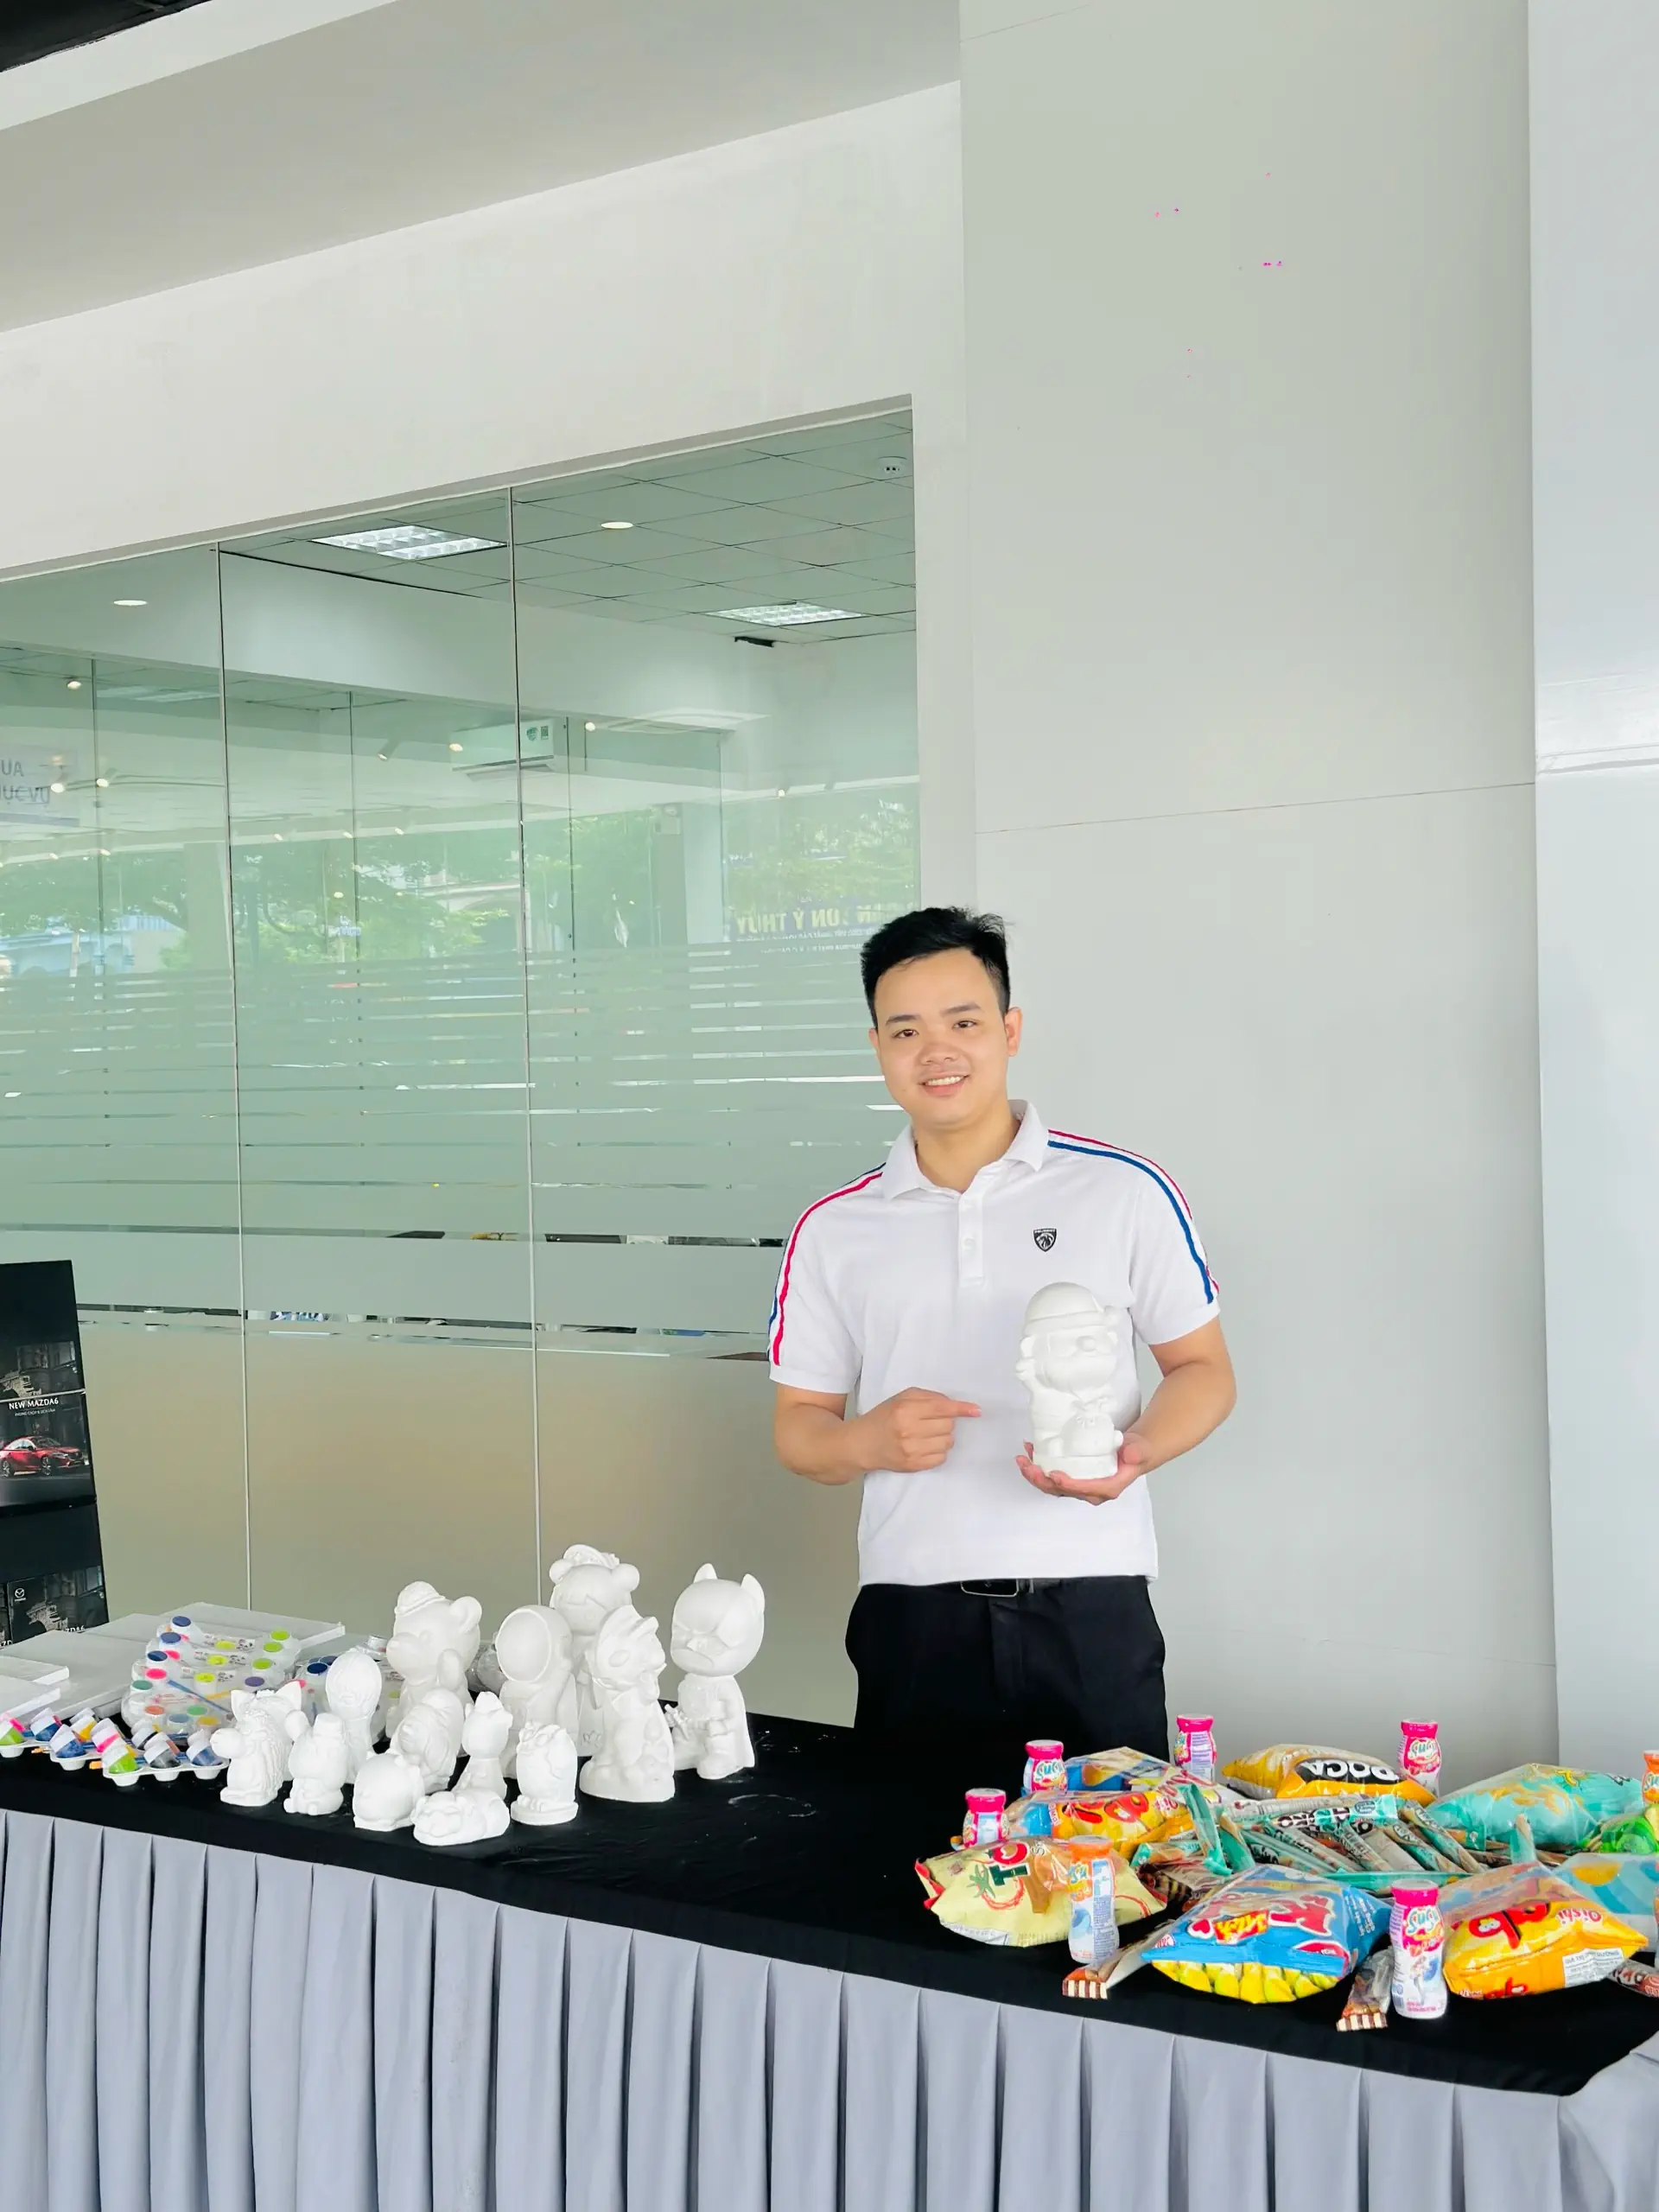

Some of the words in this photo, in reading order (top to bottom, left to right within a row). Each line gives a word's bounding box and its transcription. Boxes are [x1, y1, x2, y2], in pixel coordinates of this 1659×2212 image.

[9, 1401, 25, 1410] NEW
[27, 1397, 60, 1408] MAZDA6
[1558, 1908, 1603, 1925] Oishi
